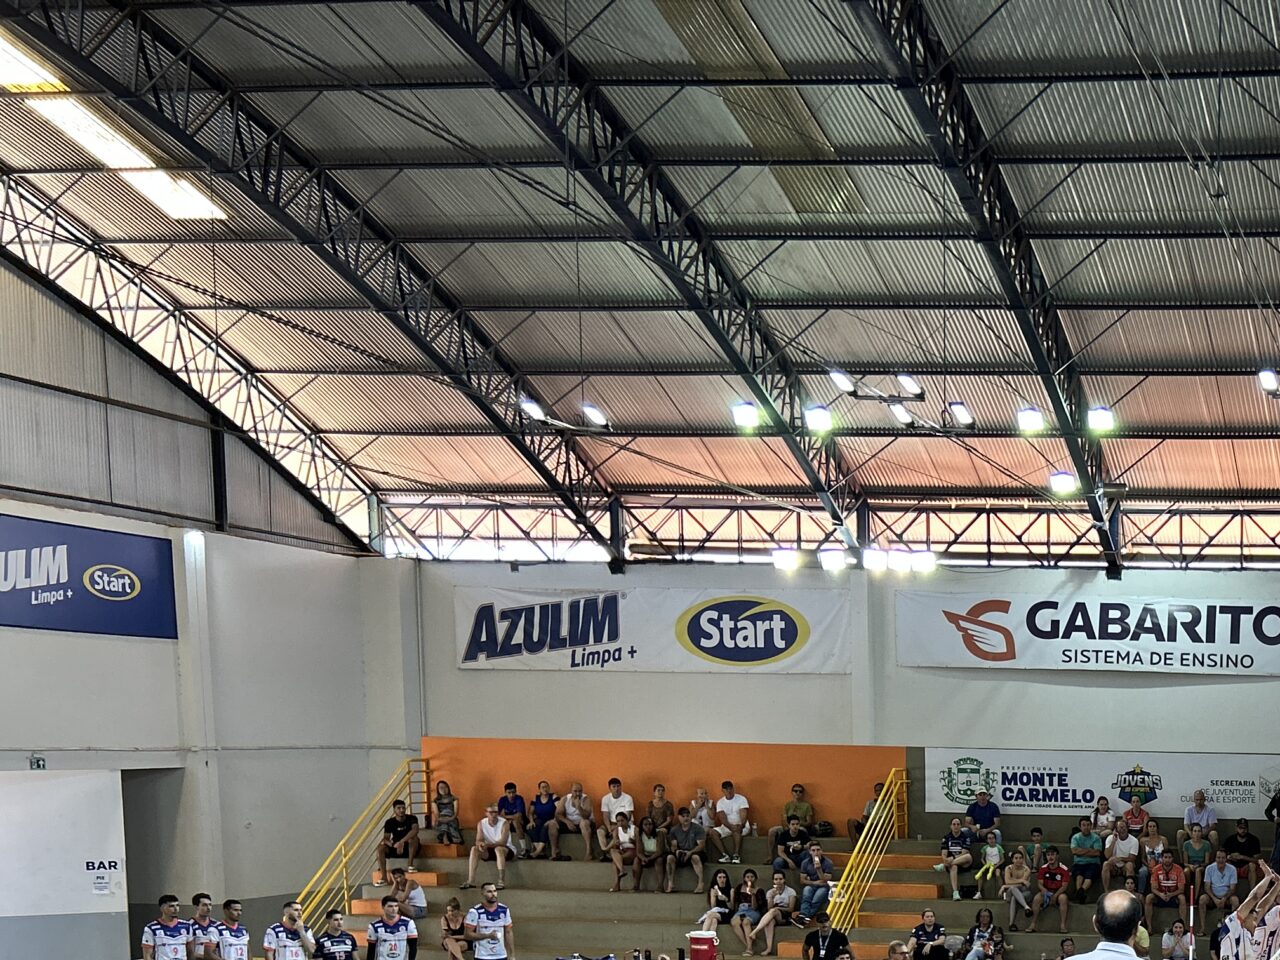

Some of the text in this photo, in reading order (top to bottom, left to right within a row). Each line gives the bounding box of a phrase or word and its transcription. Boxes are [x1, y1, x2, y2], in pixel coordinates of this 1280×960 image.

[0, 544, 68, 591] ULIM
[94, 570, 132, 594] Start
[31, 590, 64, 605] Limpa
[461, 591, 619, 663] AZULIM
[699, 609, 786, 650] Start
[570, 646, 622, 668] Limpa
[1061, 648, 1254, 669] SISTEMA DE ENSINO
[1001, 772, 1069, 787] MONTE
[1112, 774, 1162, 789] JOVENS
[1210, 779, 1256, 787] SECRETARIA
[1001, 787, 1095, 803] CARMELO
[1222, 796, 1256, 804] ESPORTE
[85, 860, 118, 870] BAR
